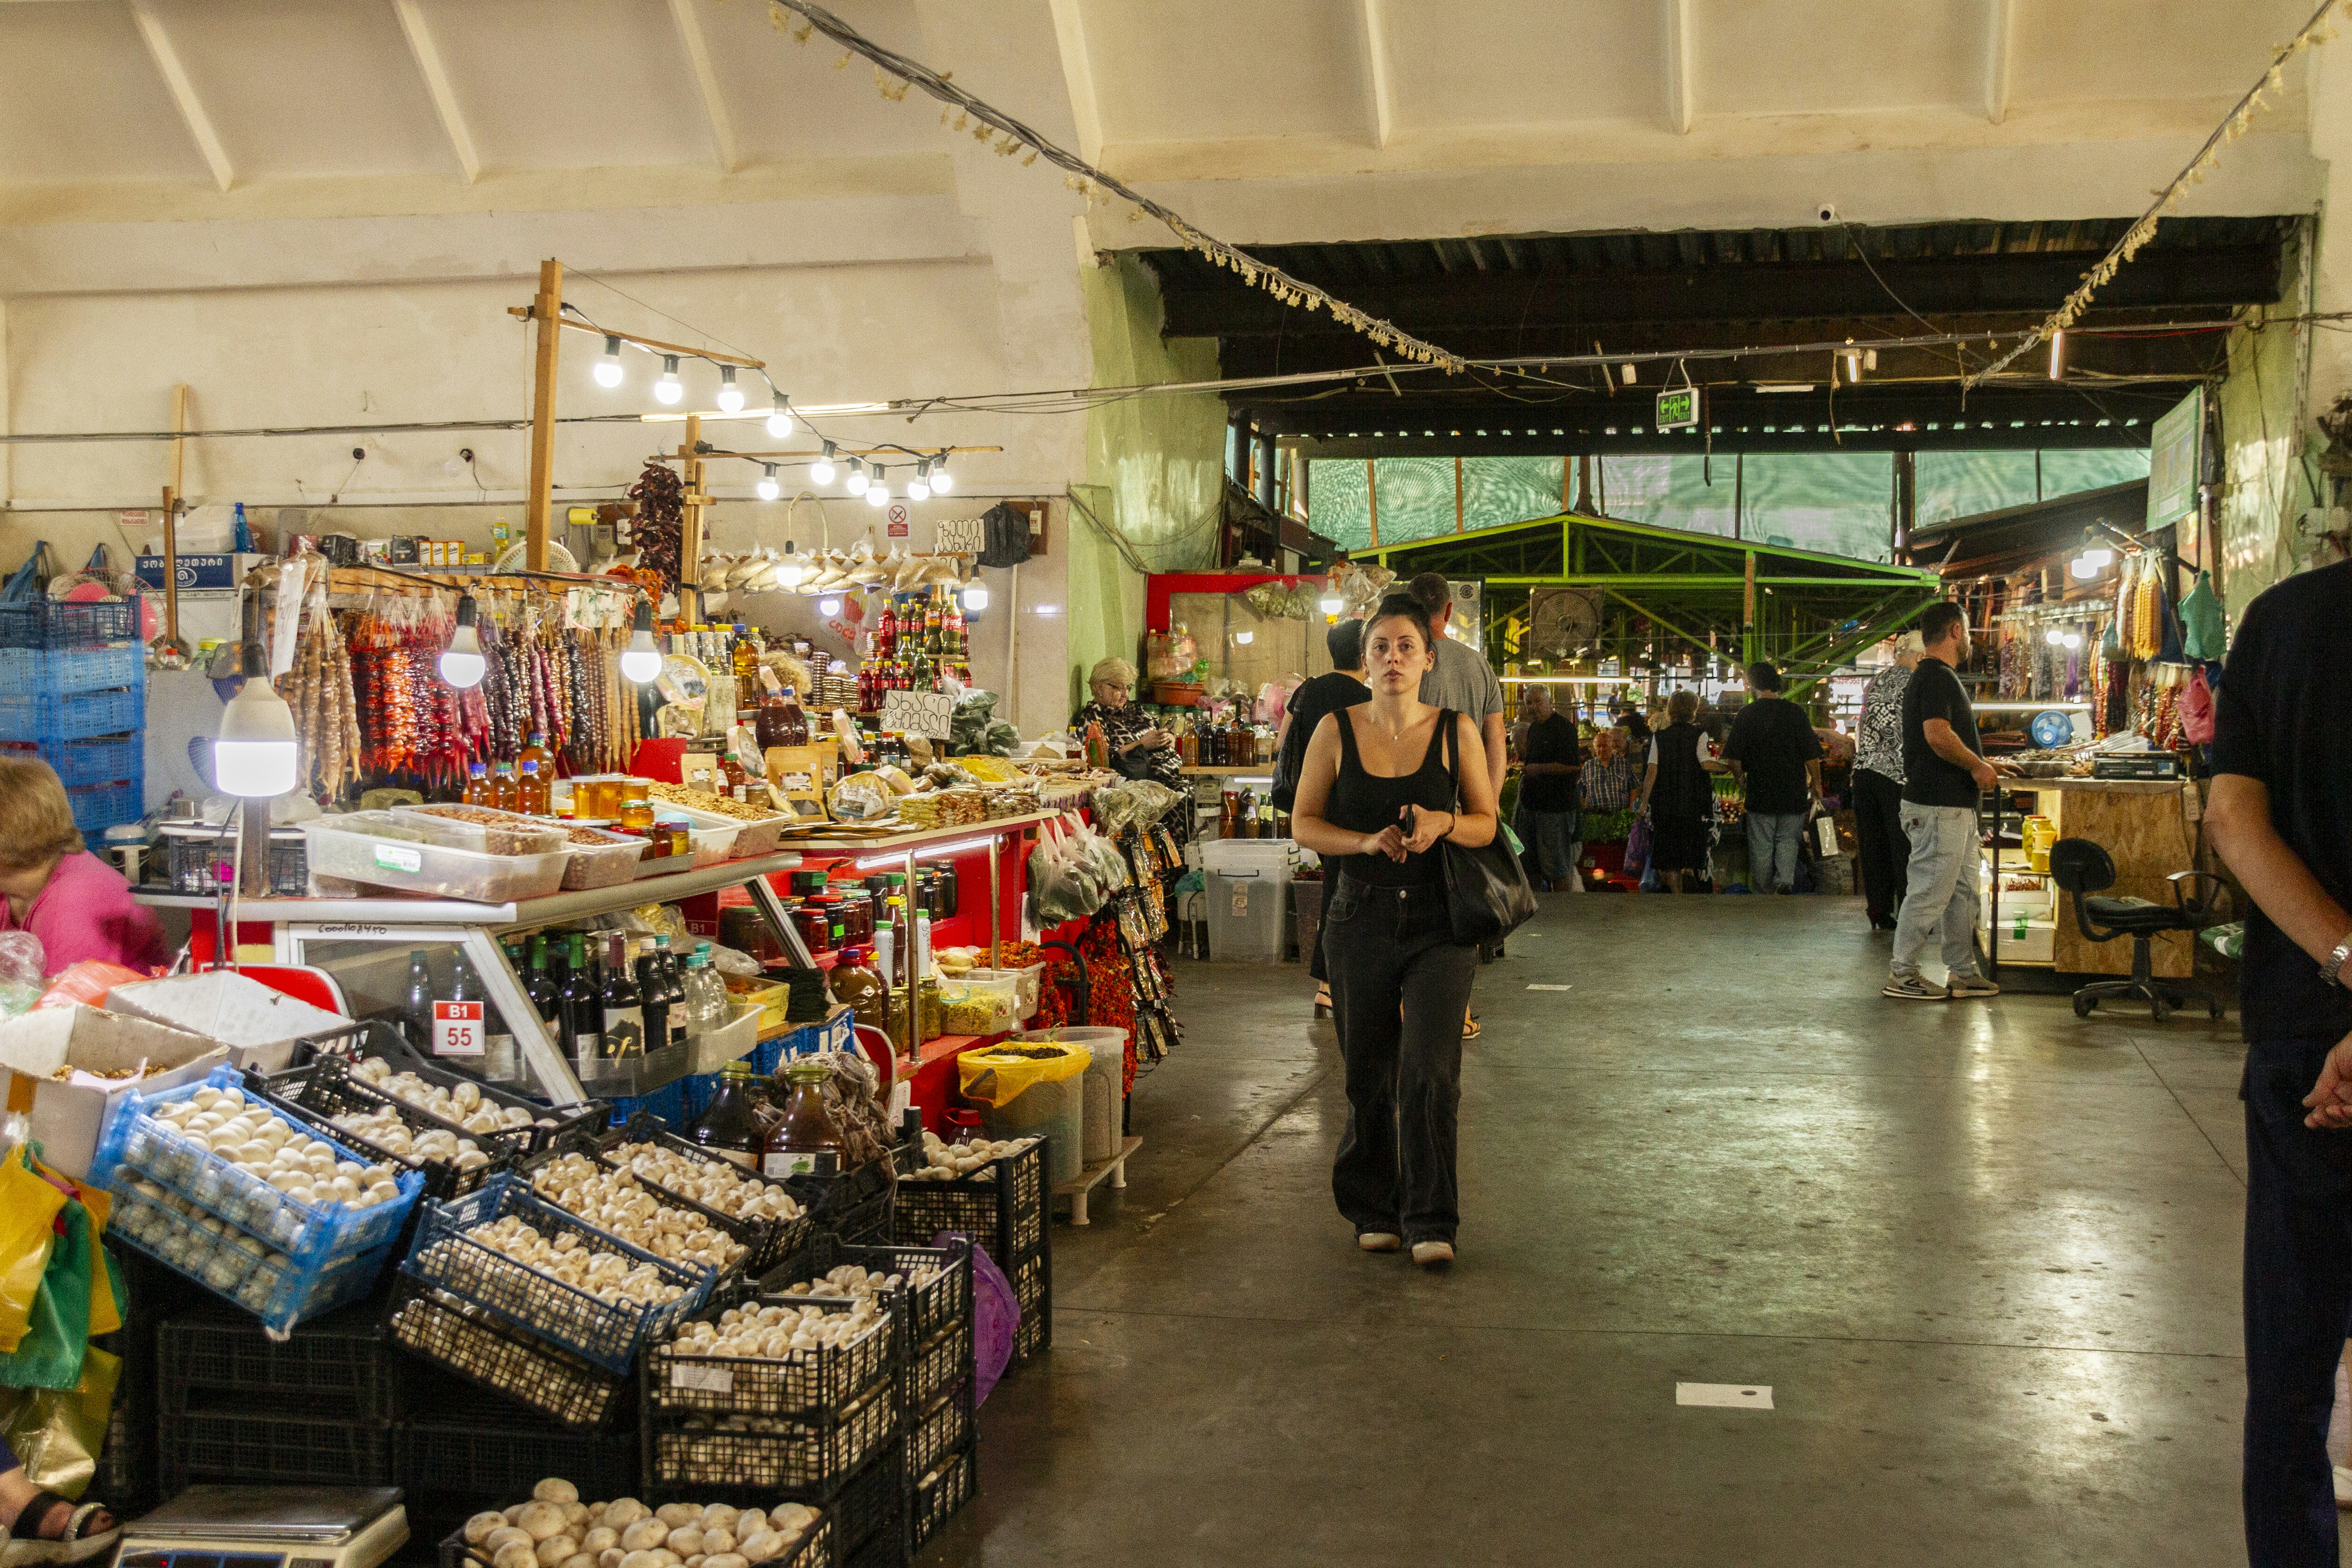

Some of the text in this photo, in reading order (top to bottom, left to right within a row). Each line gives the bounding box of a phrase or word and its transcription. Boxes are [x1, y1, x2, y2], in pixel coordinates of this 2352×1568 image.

[938, 519, 979, 537] ზეთი
[938, 536, 980, 552] კახური
[143, 558, 222, 568] ქობლეთური
[887, 691, 951, 715] ახალი
[885, 710, 949, 733] ტყემალი
[450, 1004, 468, 1018] B1
[447, 1027, 472, 1046] 55
